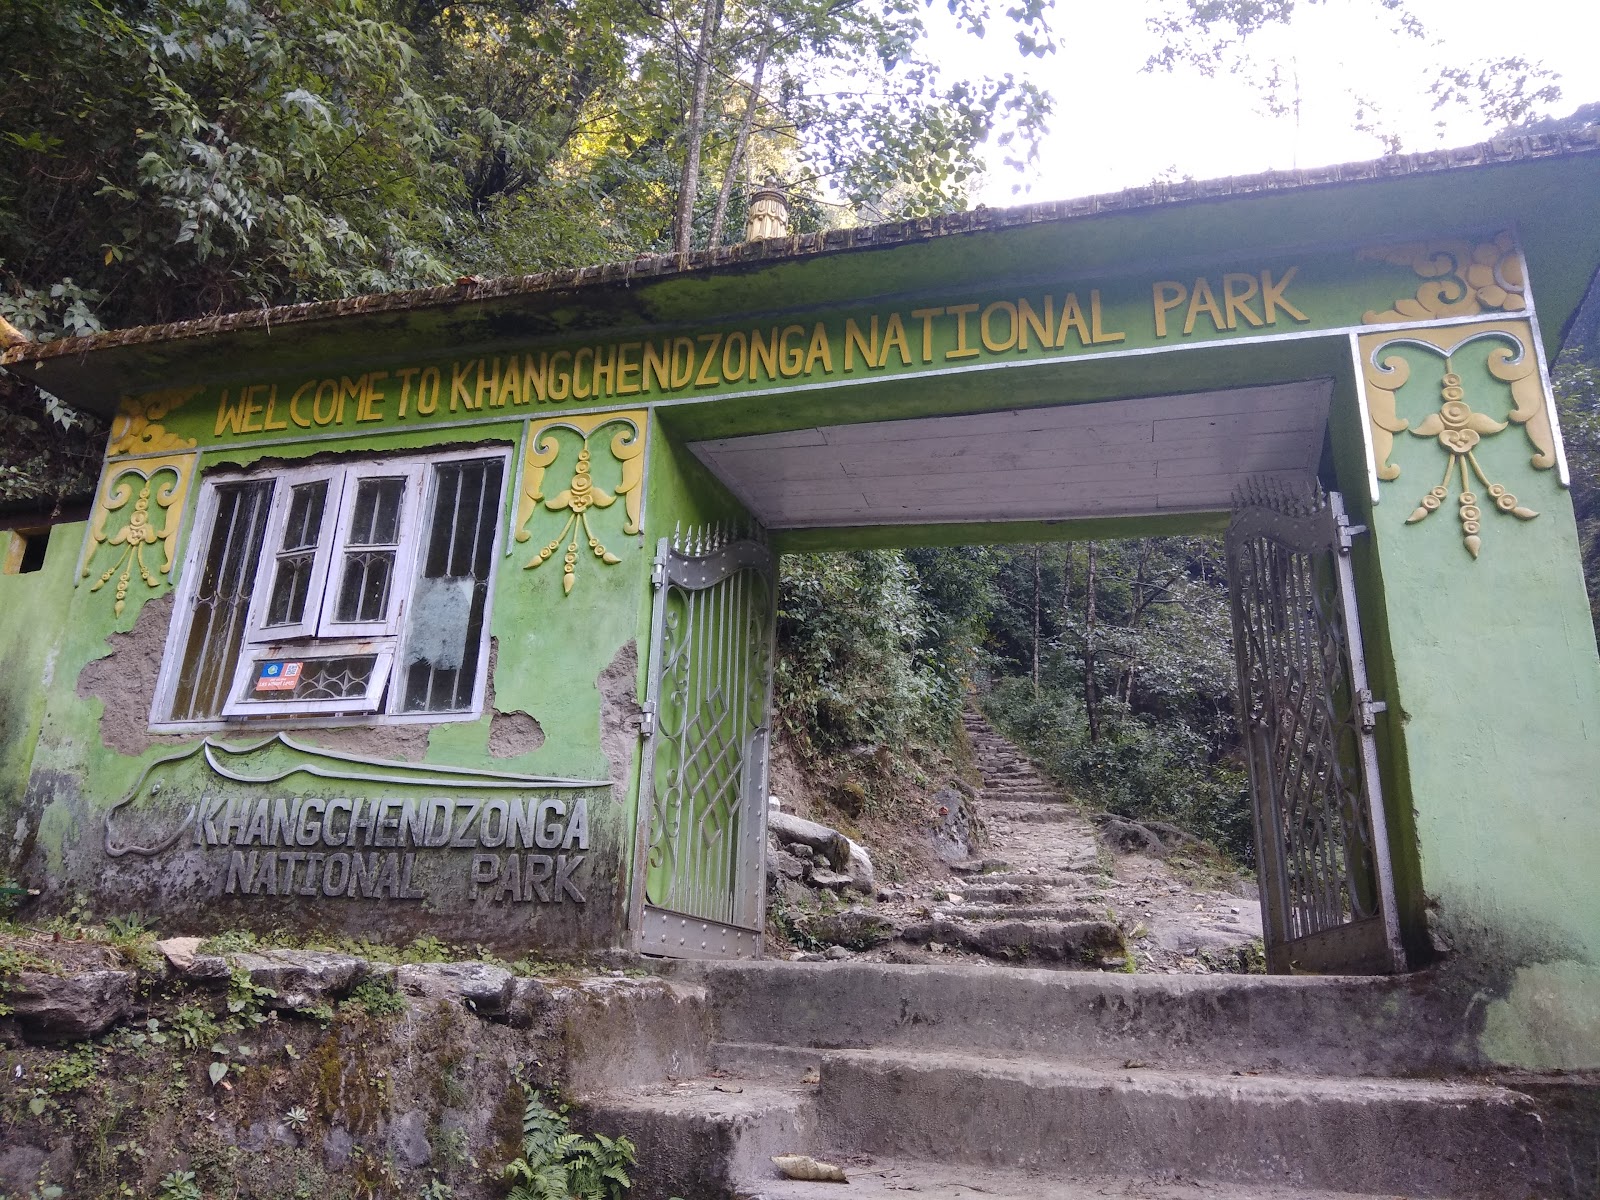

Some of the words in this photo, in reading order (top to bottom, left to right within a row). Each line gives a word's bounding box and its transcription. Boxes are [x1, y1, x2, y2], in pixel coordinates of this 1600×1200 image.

[214, 371, 385, 436] WELCOME
[398, 366, 441, 417] TO
[450, 322, 834, 411] KHANGCHENDZONGA
[844, 289, 1125, 372] NATIONAL
[1153, 266, 1310, 338] PARK
[193, 797, 590, 850] KHANGCHENDZONGA
[225, 852, 425, 900] NATIONAL
[469, 853, 586, 903] PARK
